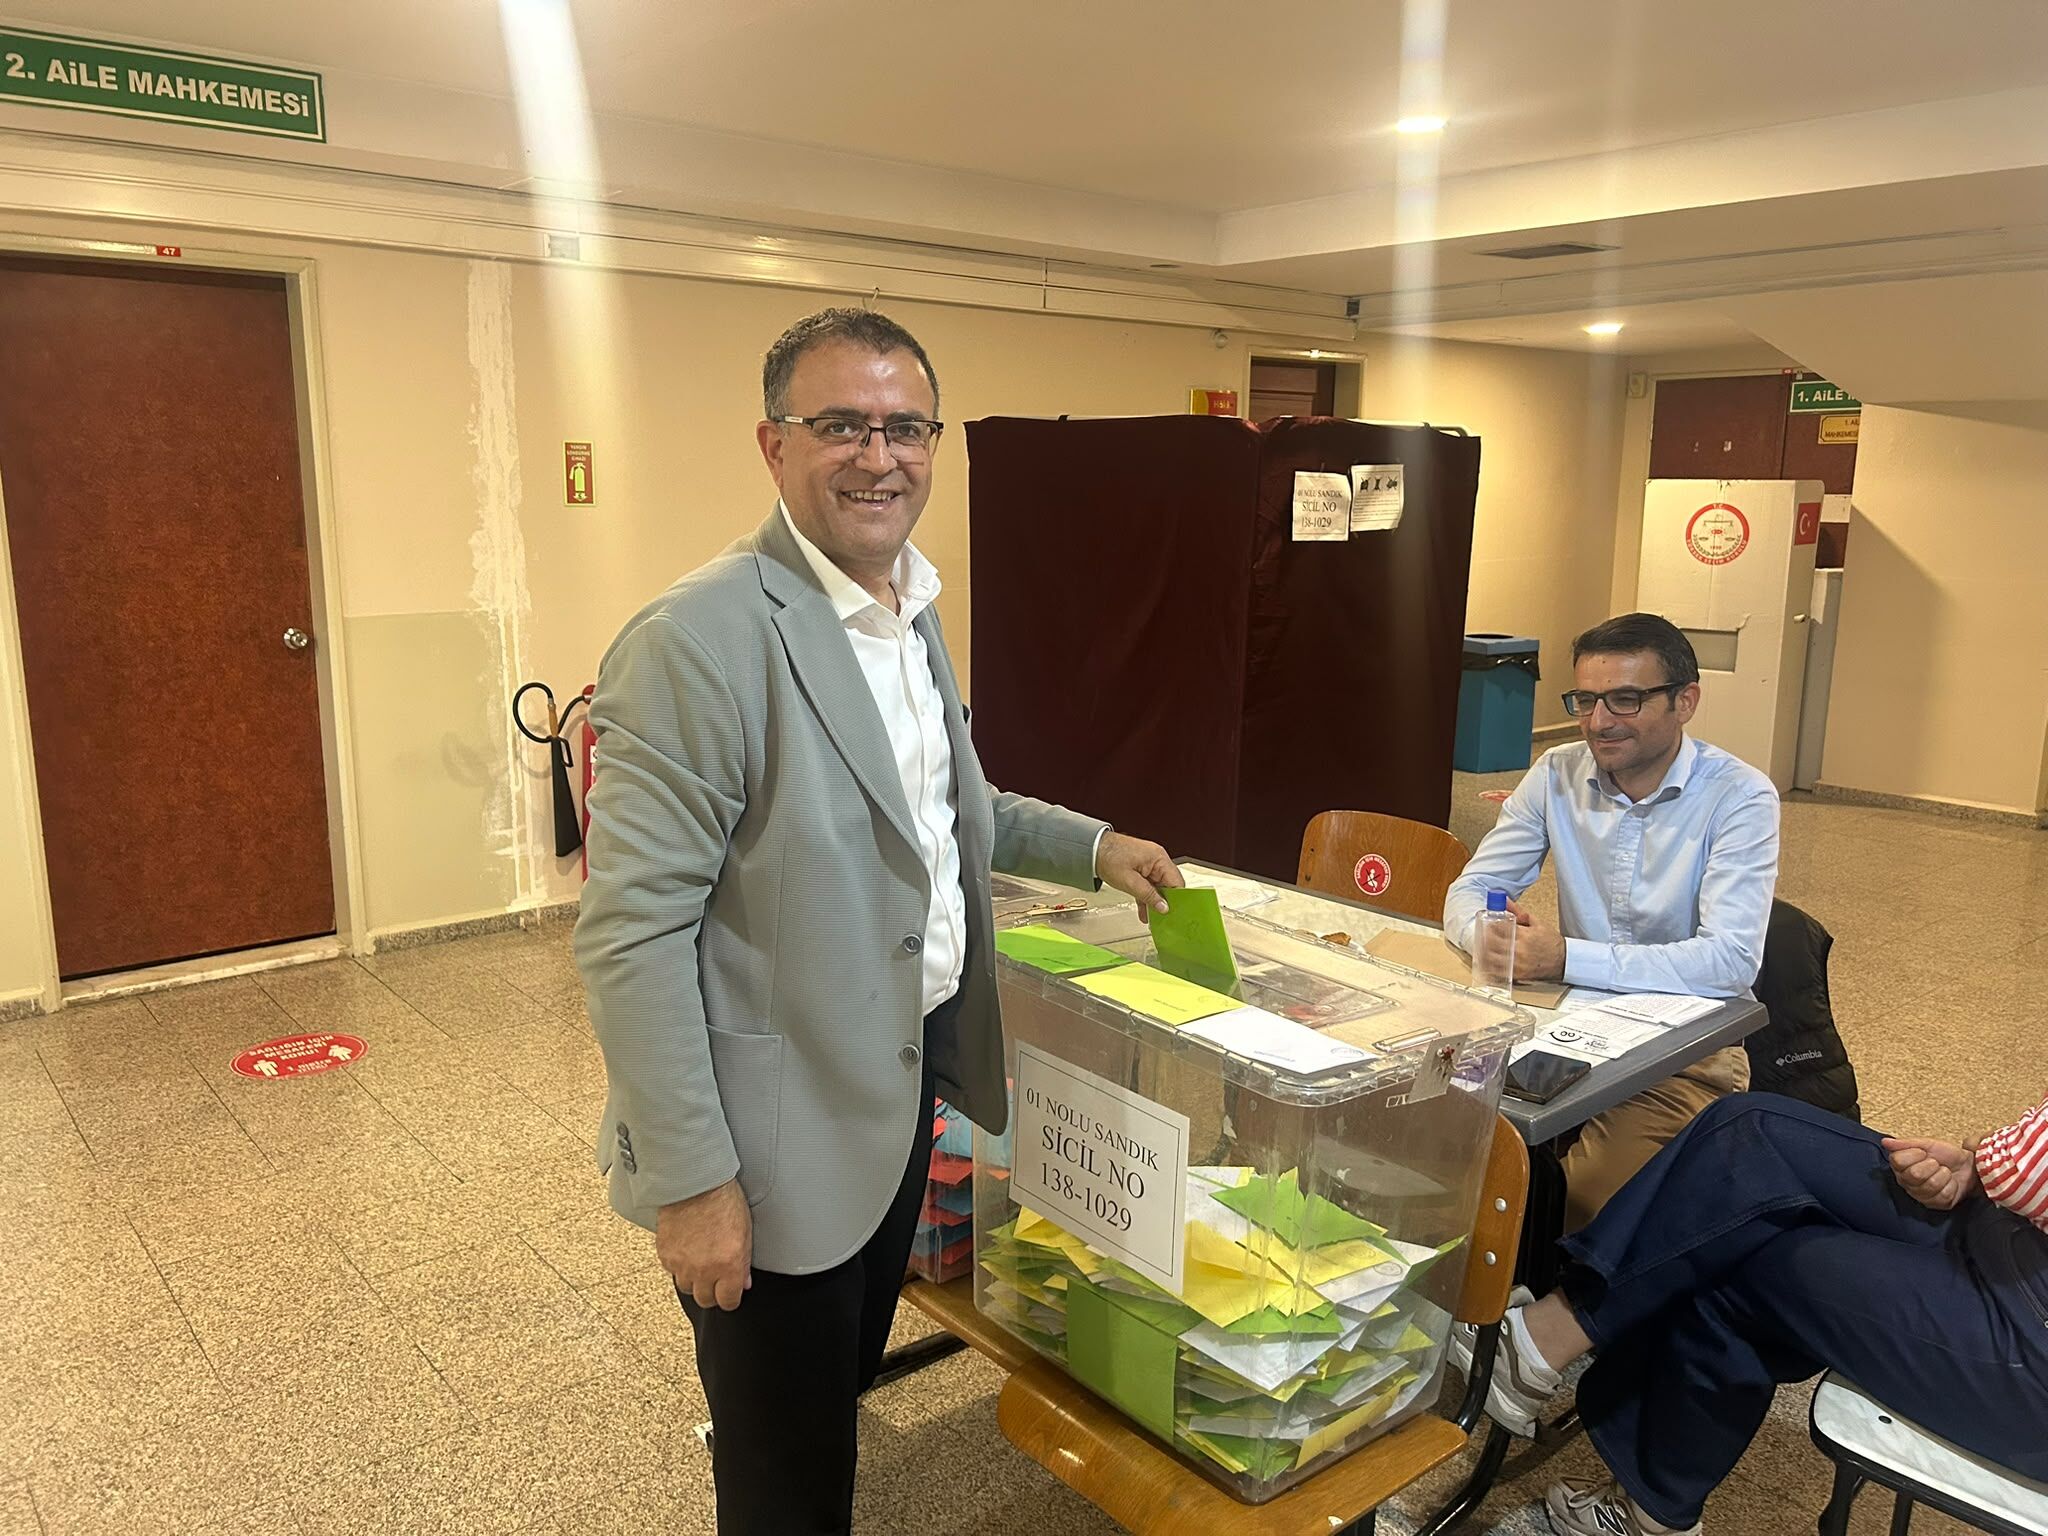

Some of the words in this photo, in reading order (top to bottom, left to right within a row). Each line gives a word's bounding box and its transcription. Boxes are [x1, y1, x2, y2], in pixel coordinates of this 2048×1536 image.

[5, 53, 35, 80] 2.
[163, 247, 176, 256] 47
[1797, 391, 1809, 402] 1.
[1322, 501, 1337, 512] NO
[1301, 517, 1332, 528] 138-1029
[1785, 1050, 1823, 1064] Columbia
[1026, 1087, 1041, 1108] 01
[1045, 1096, 1090, 1133] NOLU
[1095, 1123, 1160, 1172] SANDIK
[1041, 1124, 1101, 1178] SİCİL
[1108, 1159, 1145, 1199] NO
[1041, 1162, 1132, 1232] 138-1029
